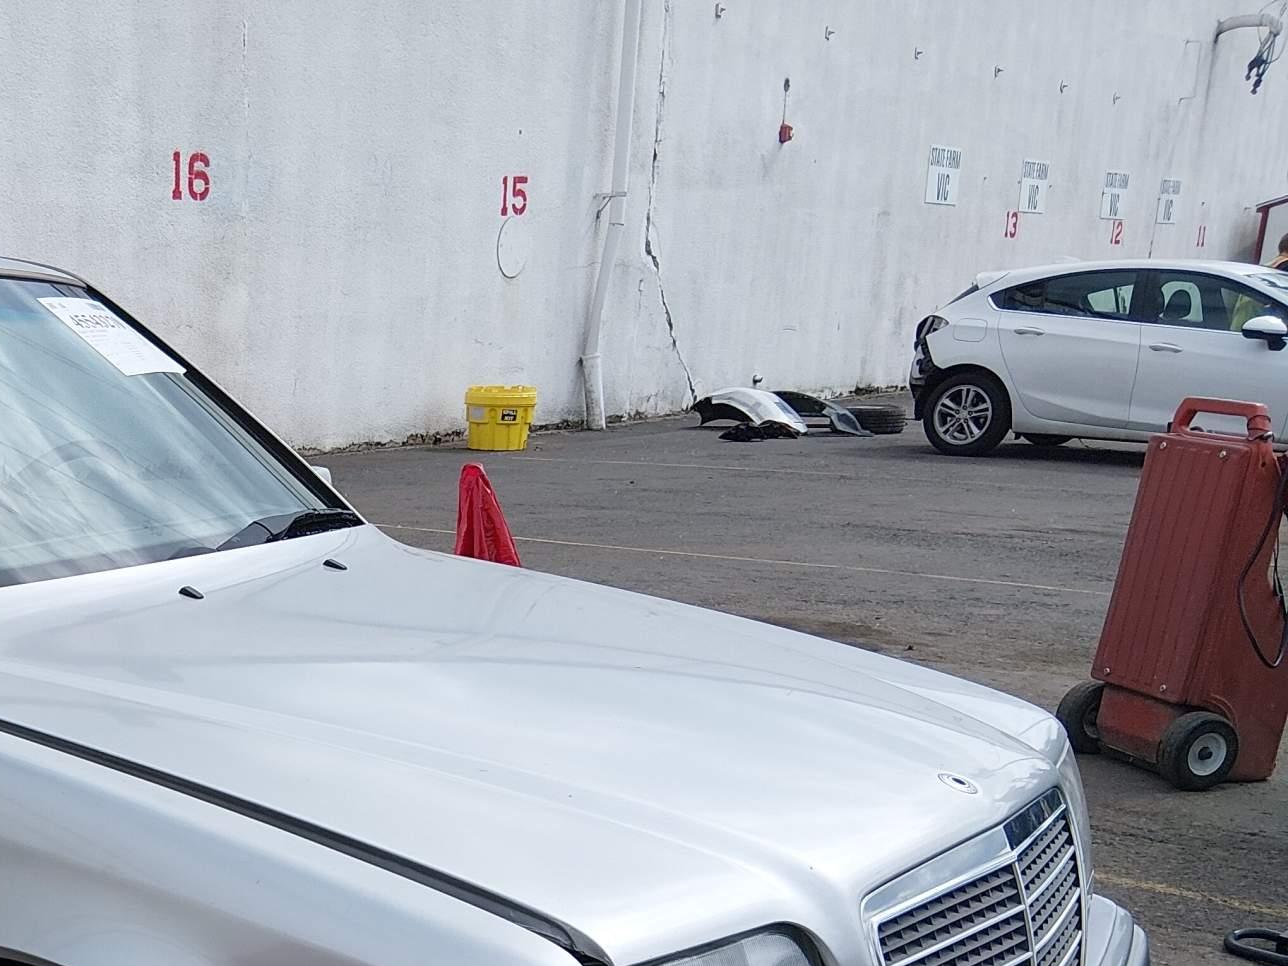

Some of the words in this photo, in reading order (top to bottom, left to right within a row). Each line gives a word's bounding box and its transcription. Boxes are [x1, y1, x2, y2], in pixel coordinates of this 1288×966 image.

[930, 147, 946, 168] STATE
[946, 149, 961, 169] FARM
[1023, 161, 1036, 179] STATE
[171, 151, 210, 201] 16
[936, 172, 950, 201] VIC
[500, 176, 528, 217] 15
[1027, 184, 1040, 210] VIC
[1004, 211, 1018, 238] 13
[1110, 220, 1123, 245] 12
[1196, 225, 1206, 247] 11
